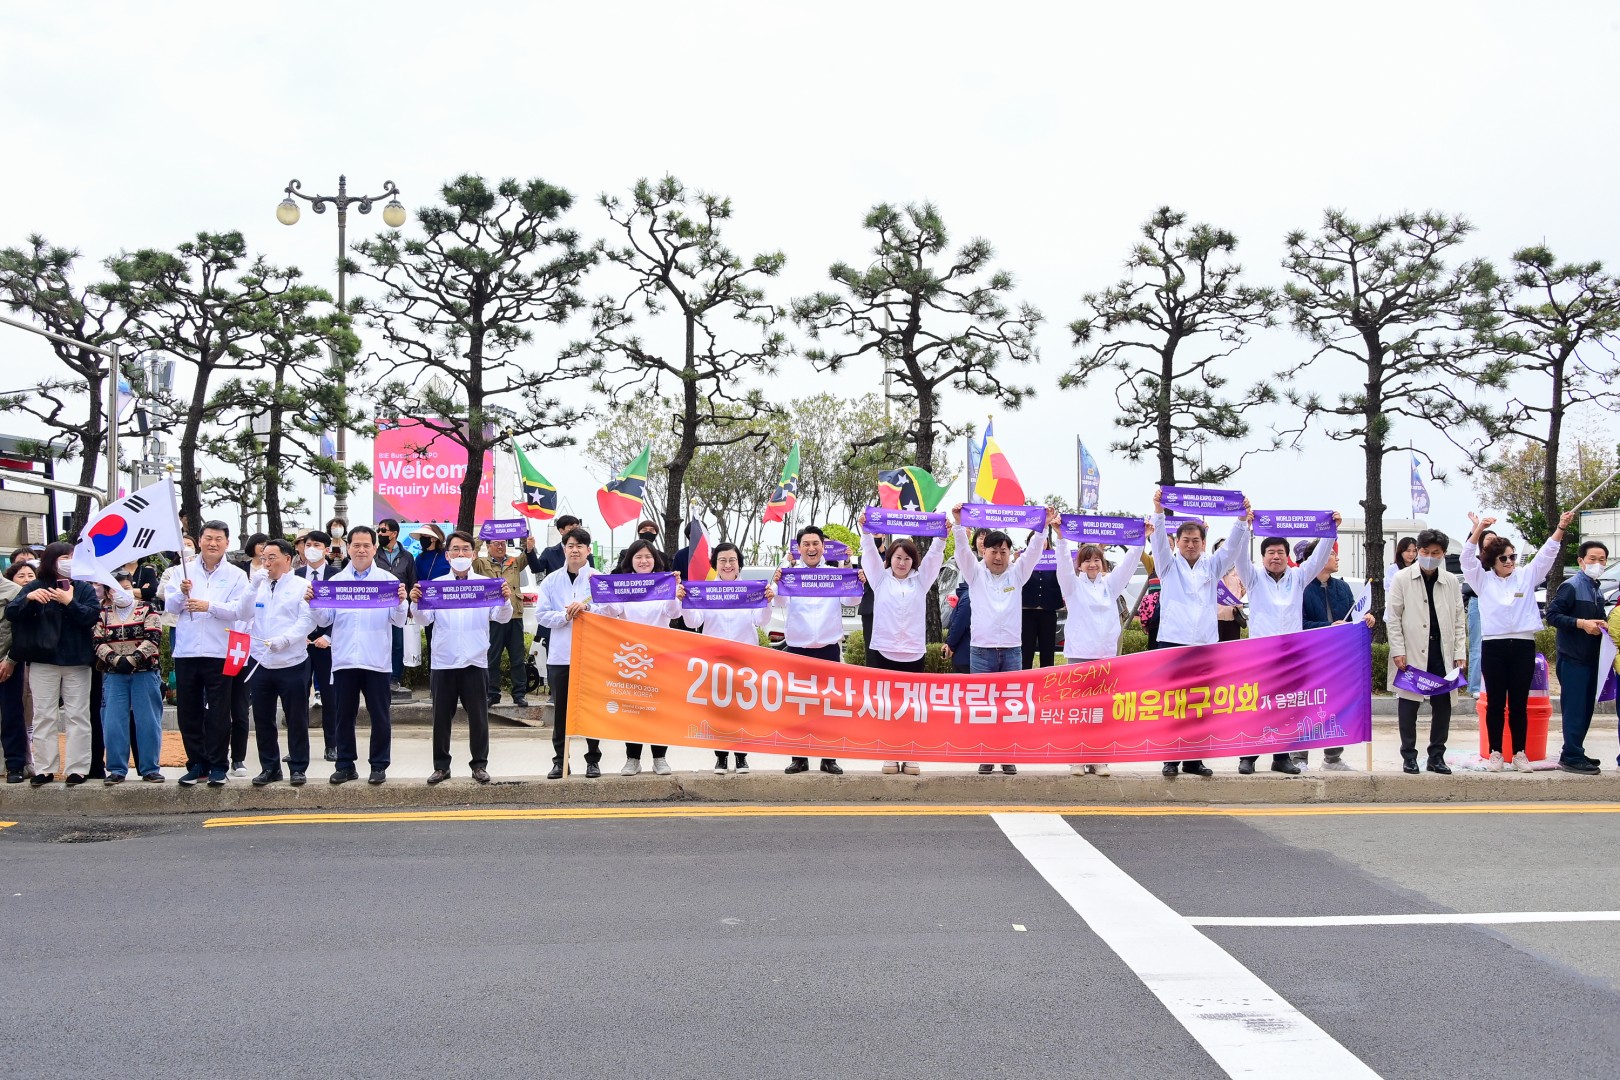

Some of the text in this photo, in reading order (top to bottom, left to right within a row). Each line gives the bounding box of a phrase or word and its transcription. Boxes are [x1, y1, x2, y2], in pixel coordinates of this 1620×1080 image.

[379, 460, 487, 480] Welcom,
[378, 483, 430, 498] Enquiry
[1043, 662, 1110, 688] BUSAN
[1038, 678, 1118, 703] is Ready!
[1040, 708, 1064, 724] 부산
[1068, 708, 1104, 724] 유치를
[1275, 688, 1328, 709] 응원합니다
